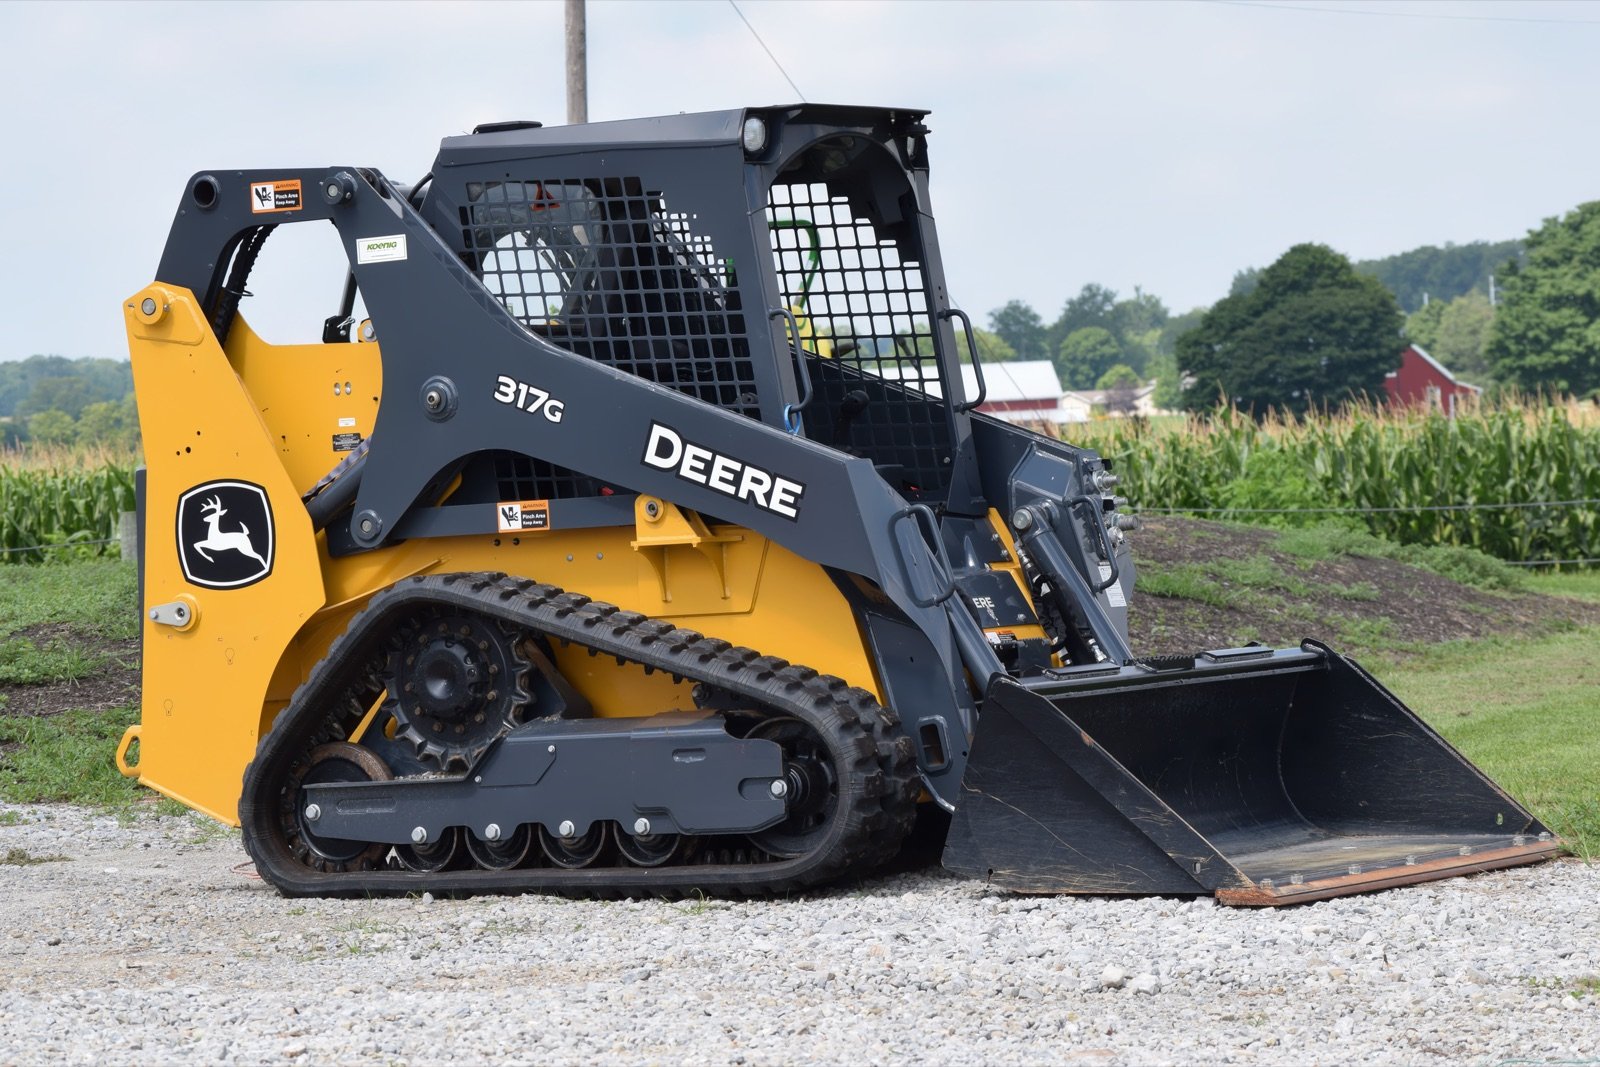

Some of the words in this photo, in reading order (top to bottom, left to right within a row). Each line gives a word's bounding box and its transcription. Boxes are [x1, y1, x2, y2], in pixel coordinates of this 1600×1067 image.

[494, 375, 565, 423] 317G
[644, 423, 803, 518] DEERE
[972, 597, 995, 609] ERE
